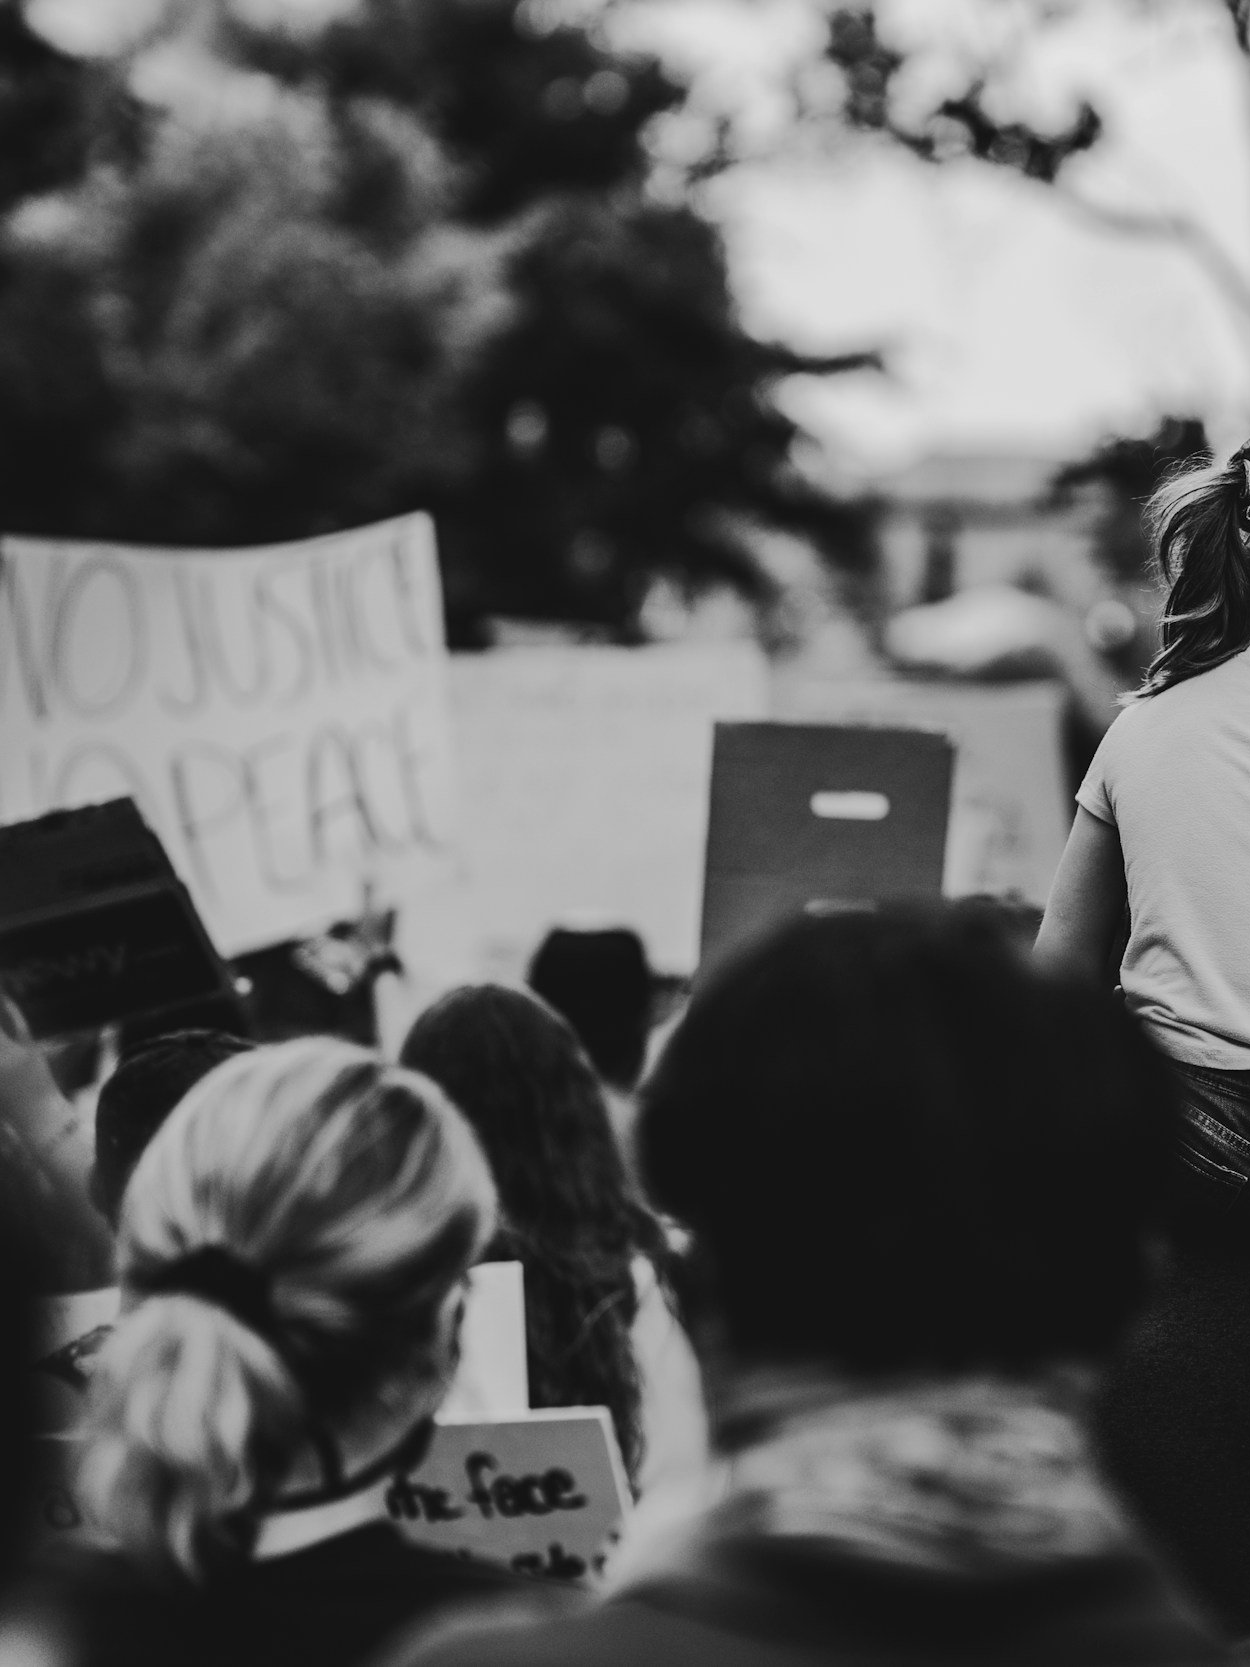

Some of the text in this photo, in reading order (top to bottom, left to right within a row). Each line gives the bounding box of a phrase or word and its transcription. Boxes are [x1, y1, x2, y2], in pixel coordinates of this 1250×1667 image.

[0, 550, 150, 728] NO
[168, 700, 462, 912] PEACE
[465, 1452, 586, 1518] face
